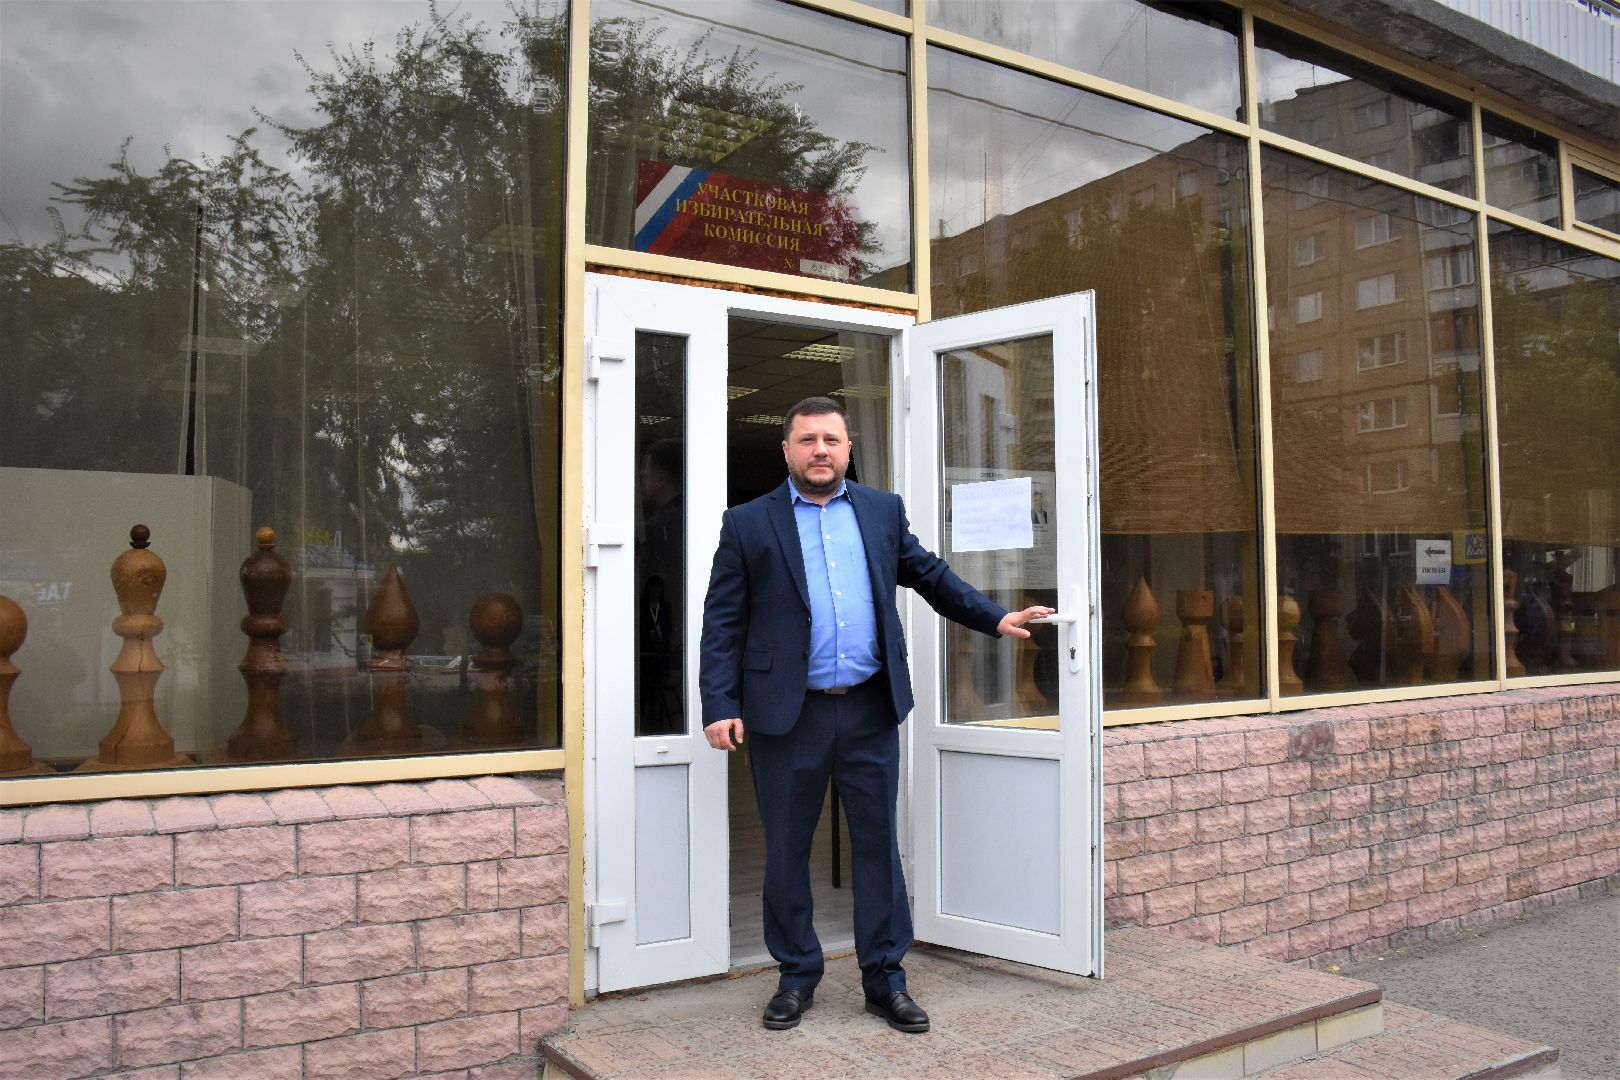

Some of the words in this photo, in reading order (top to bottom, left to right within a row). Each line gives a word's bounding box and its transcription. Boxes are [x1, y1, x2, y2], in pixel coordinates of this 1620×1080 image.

[697, 183, 809, 215] УЧАСТКОВАЯ
[675, 198, 823, 237] ИЗБИРАТЕЛЬНАЯ
[703, 223, 801, 251] КОМИССИЯ
